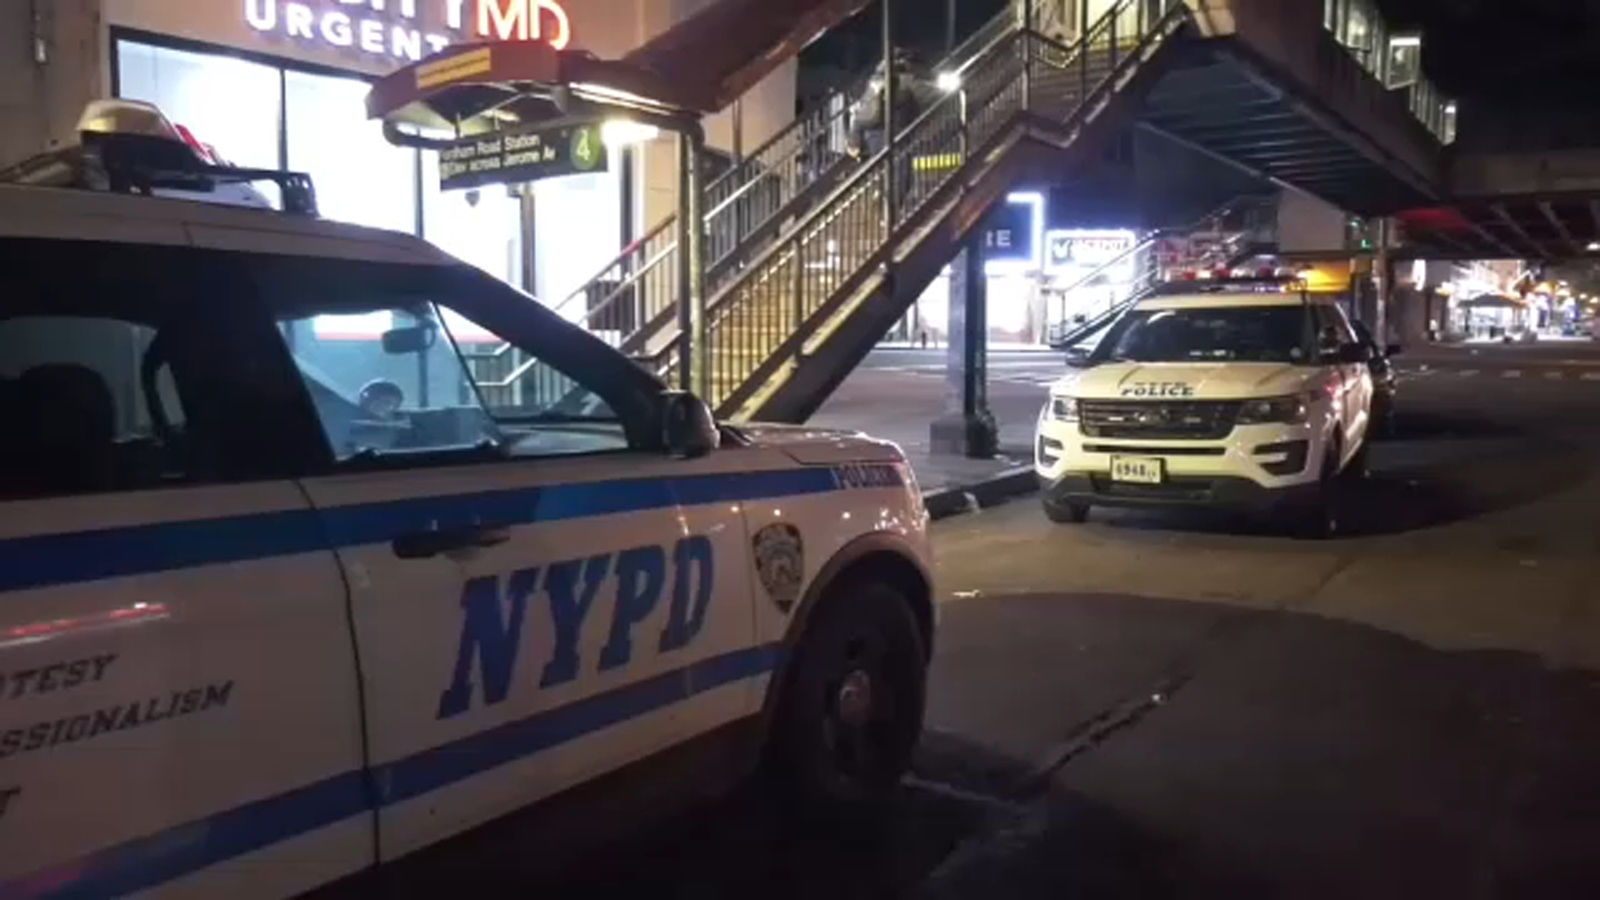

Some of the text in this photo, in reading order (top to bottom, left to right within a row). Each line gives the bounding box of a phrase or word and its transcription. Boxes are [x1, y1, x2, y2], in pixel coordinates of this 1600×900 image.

[245, 0, 449, 61] URGENT
[477, 140, 501, 155] Road
[504, 134, 540, 151] Station
[576, 129, 591, 161] 4
[503, 151, 540, 167] Jerome
[1121, 386, 1194, 397] POLICE
[436, 535, 714, 720] NYPD
